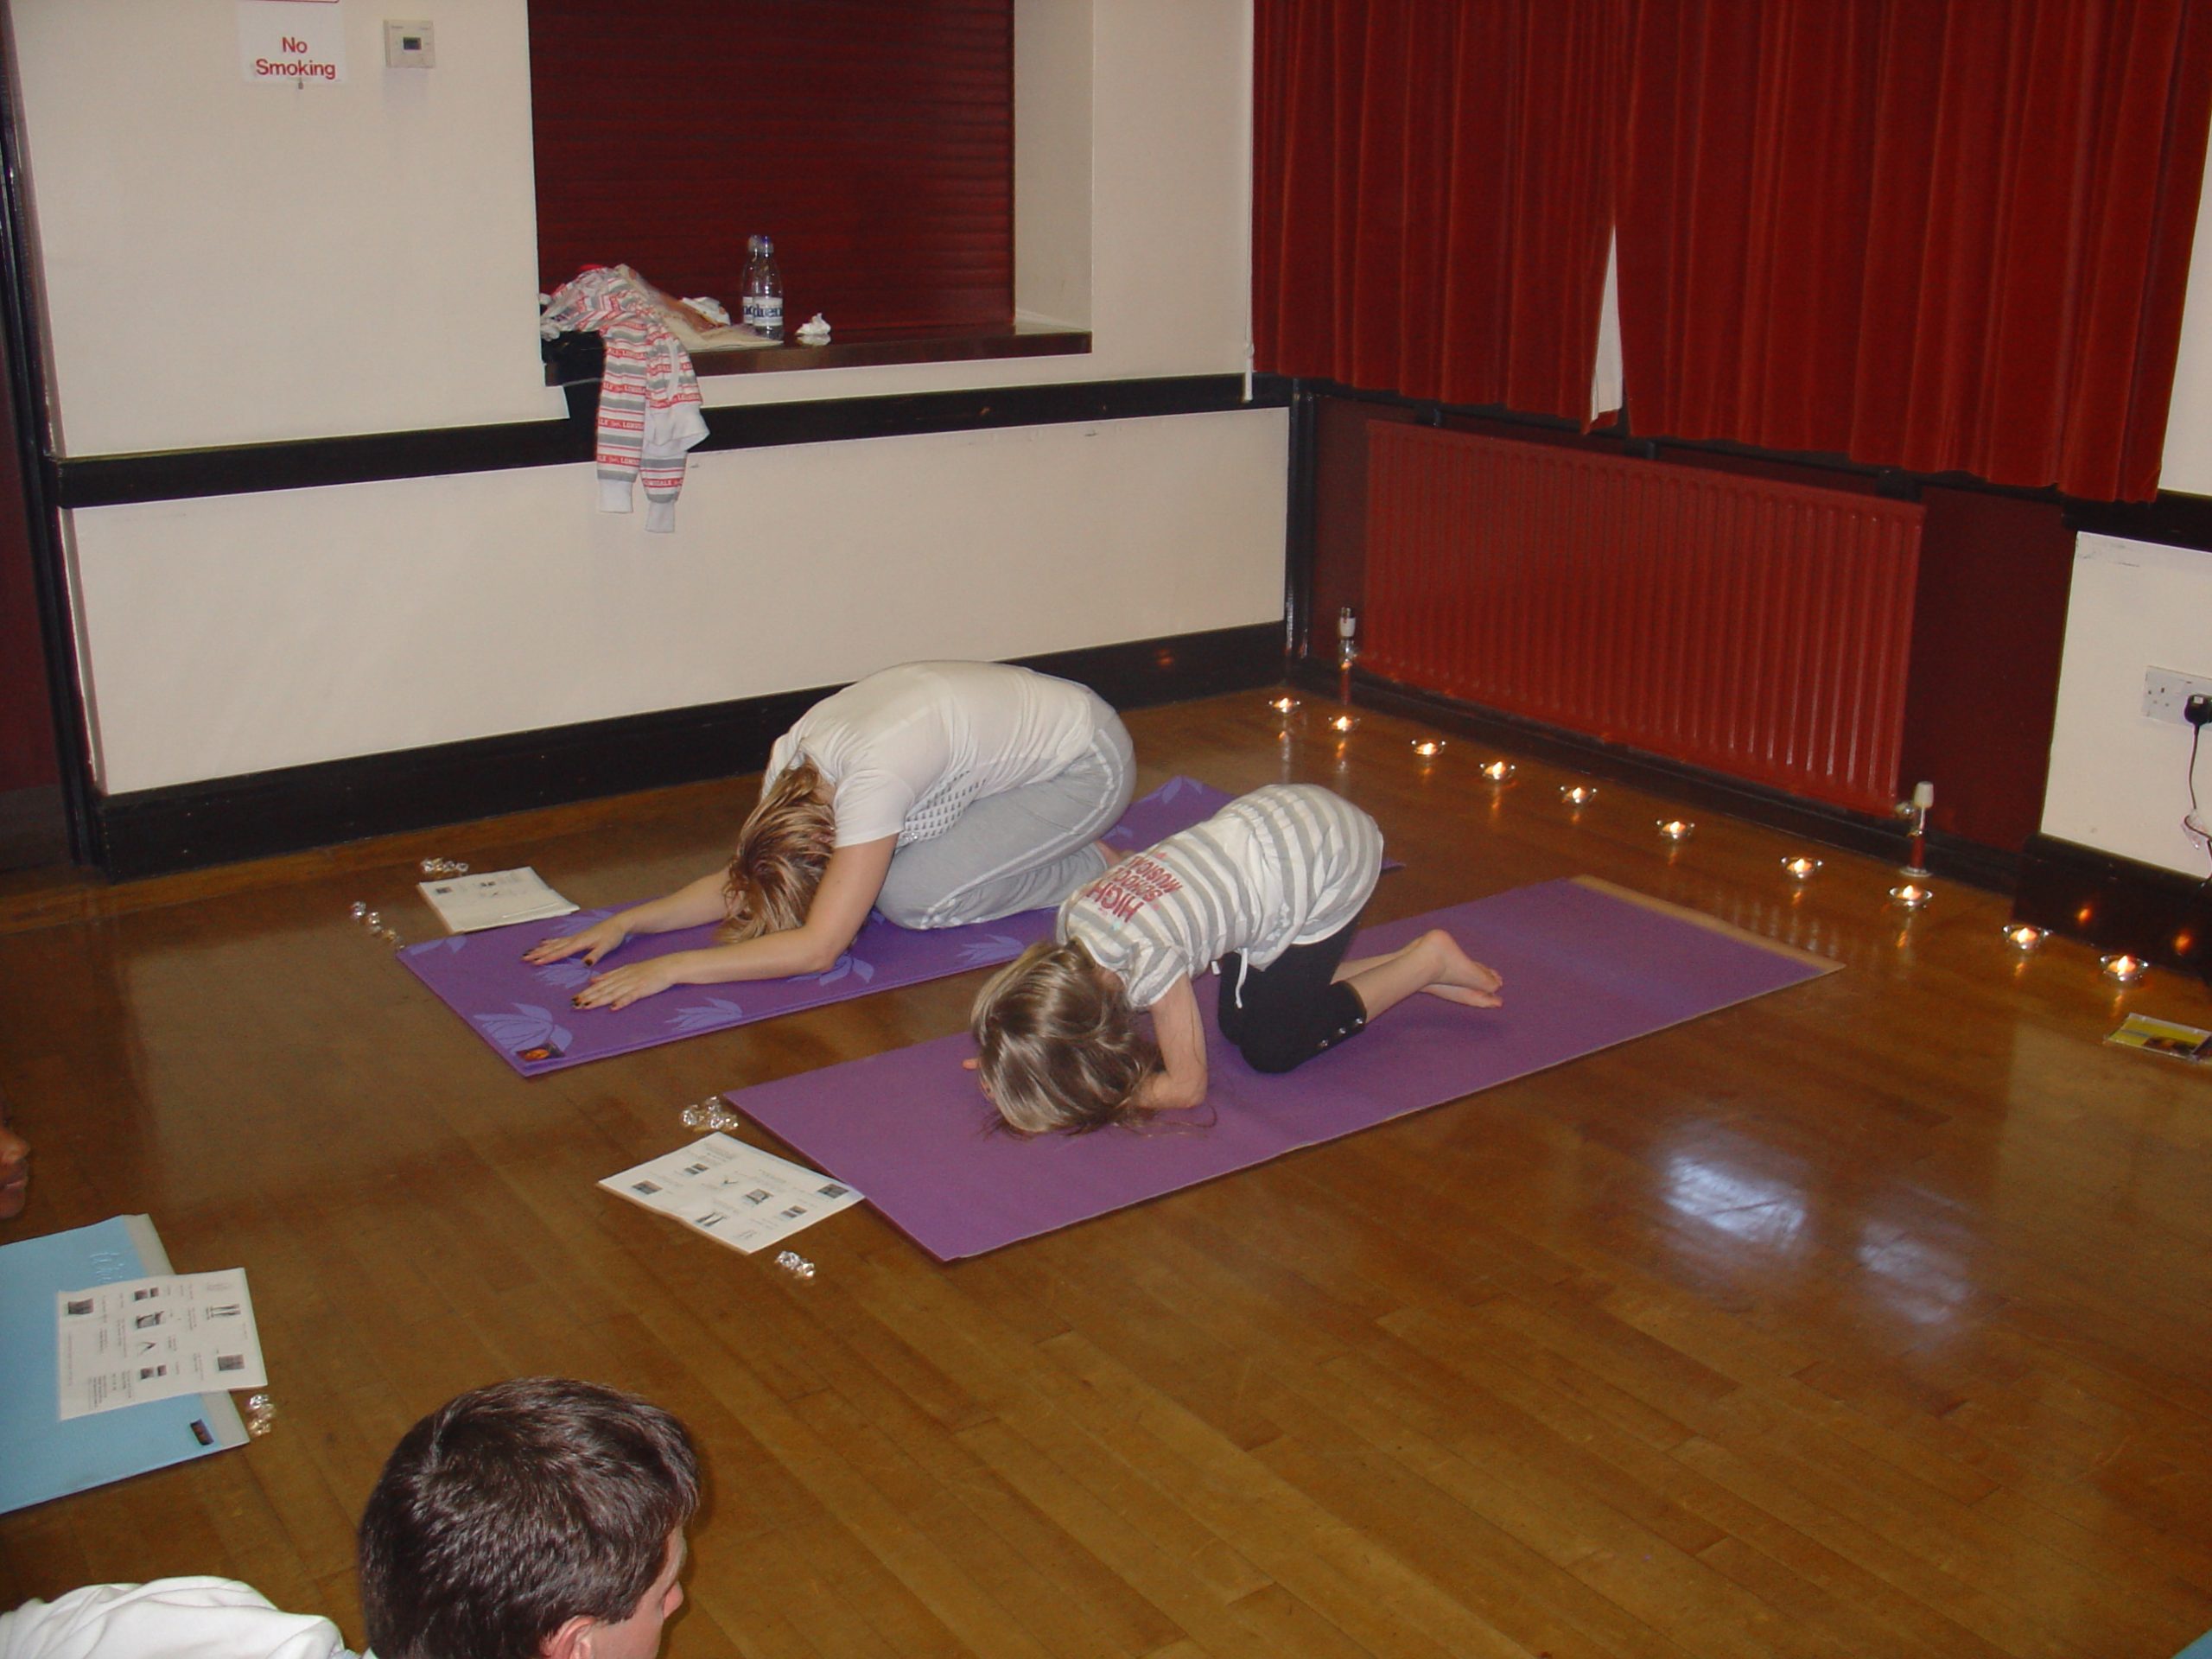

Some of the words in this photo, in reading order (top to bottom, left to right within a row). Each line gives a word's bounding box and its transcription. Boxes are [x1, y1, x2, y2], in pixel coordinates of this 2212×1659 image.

[282, 36, 308, 54] No
[256, 59, 336, 79] Smoking
[1085, 879, 1144, 923] HIGH
